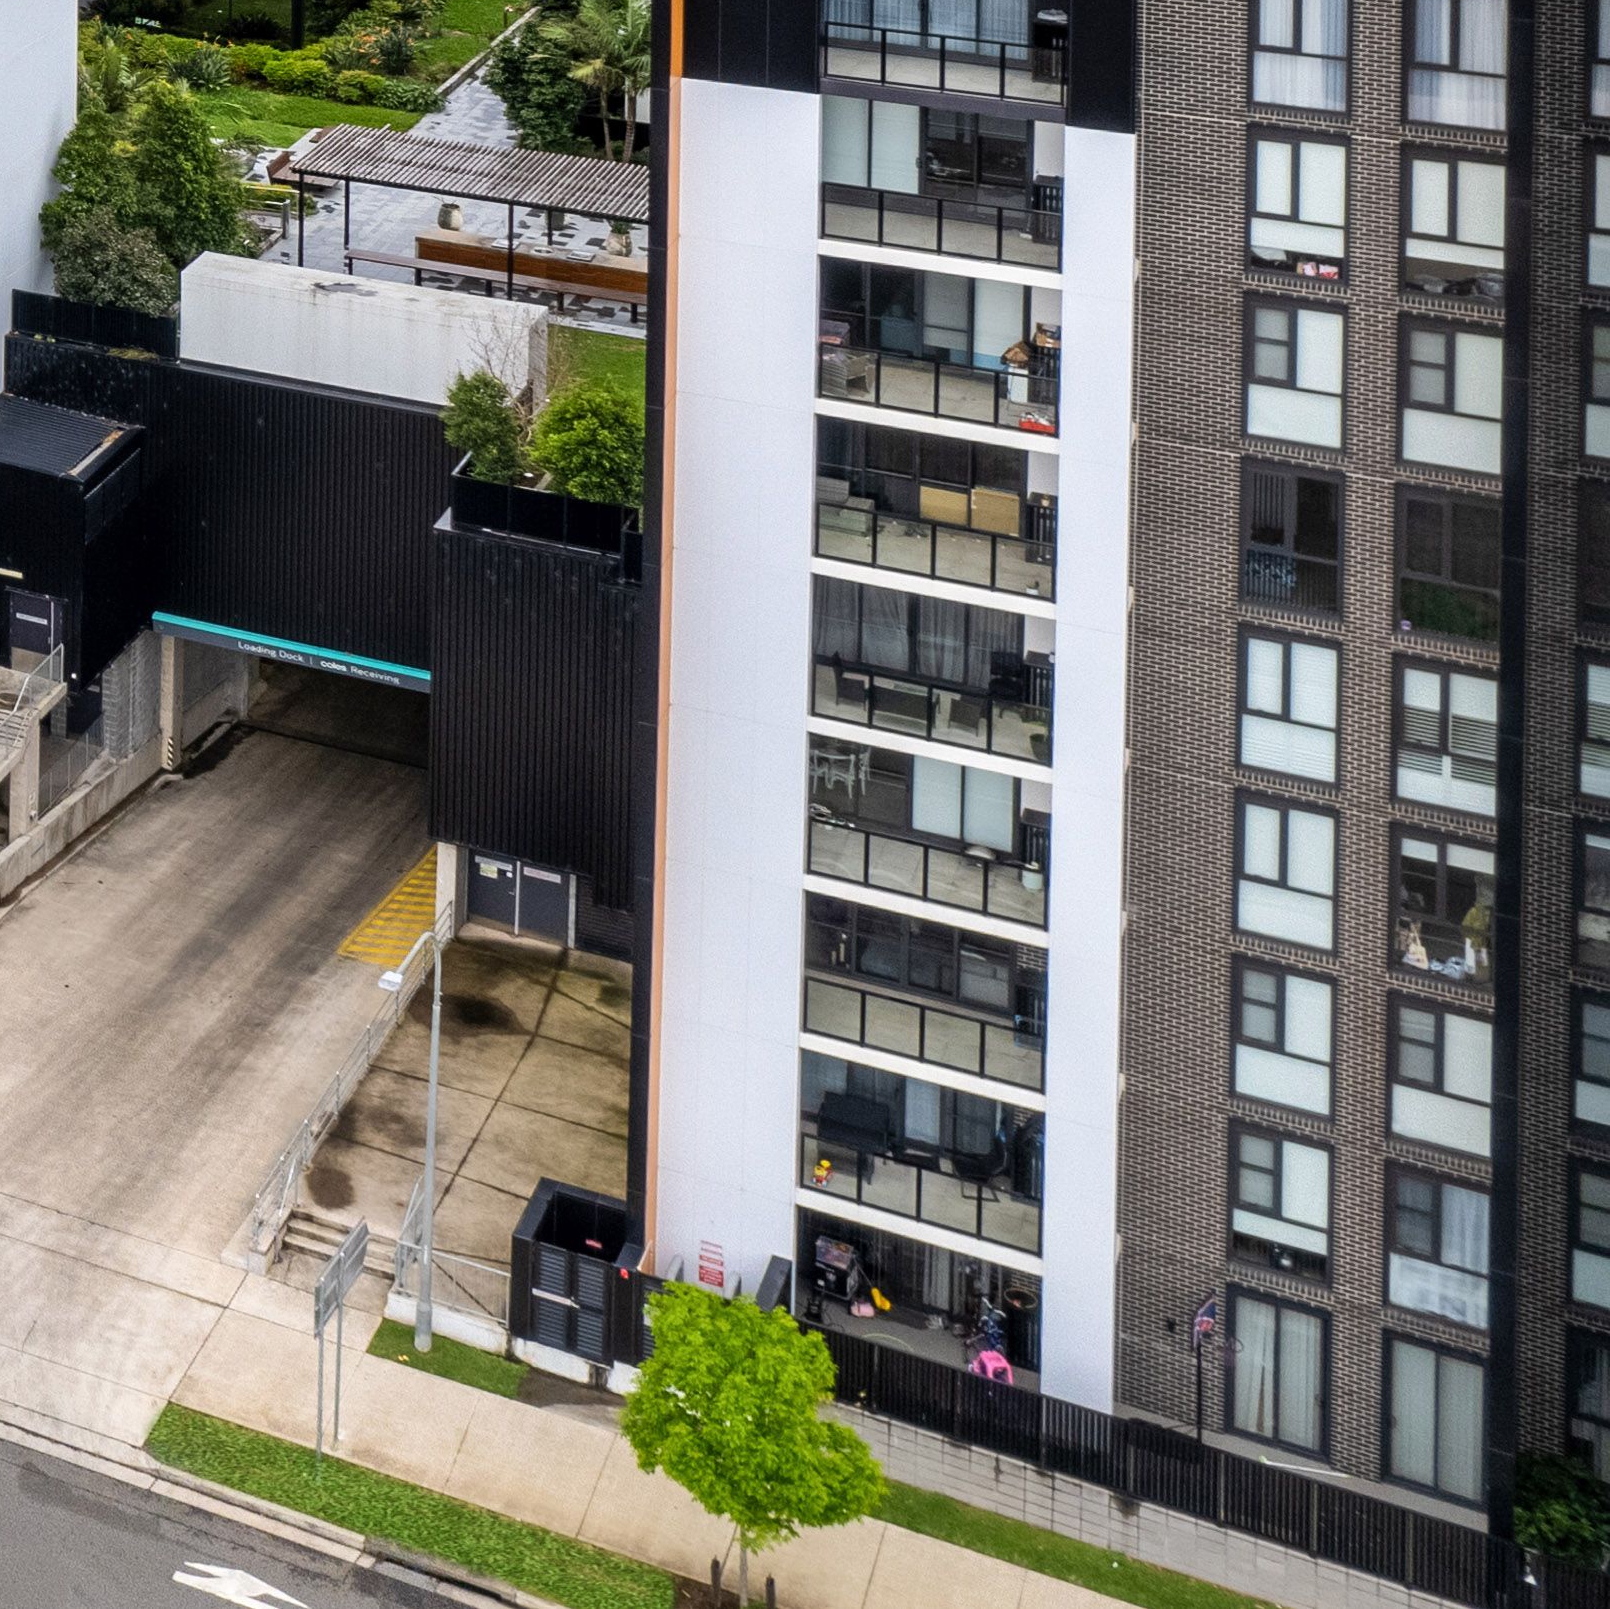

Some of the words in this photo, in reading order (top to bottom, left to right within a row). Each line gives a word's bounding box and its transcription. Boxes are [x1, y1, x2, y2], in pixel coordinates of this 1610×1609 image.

[238, 641, 277, 658] Loading
[279, 649, 304, 662] Dock
[320, 660, 347, 672] coles
[350, 666, 401, 685] Receiving
